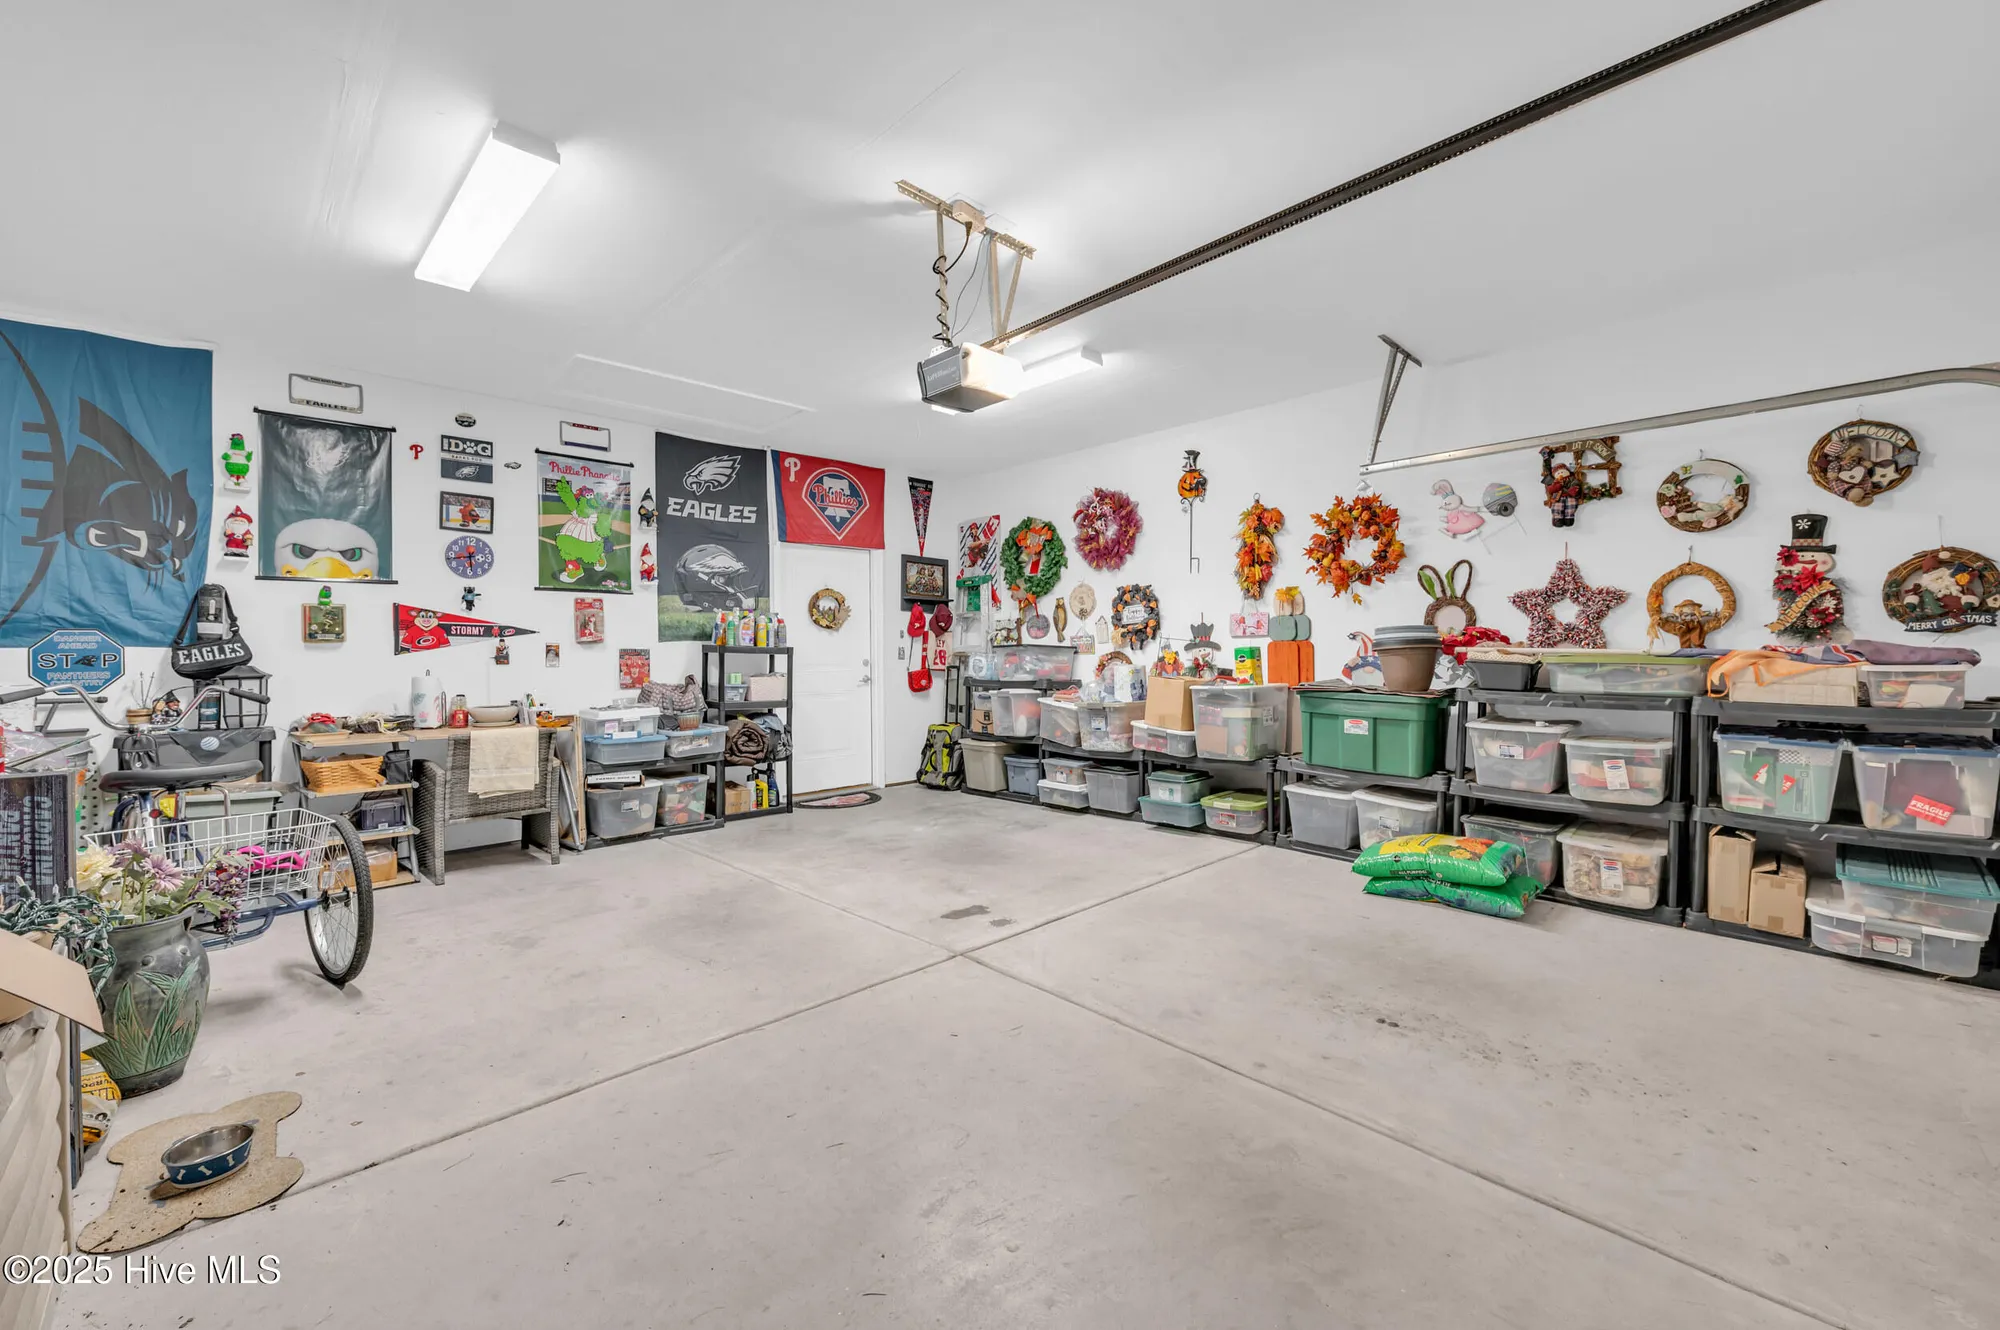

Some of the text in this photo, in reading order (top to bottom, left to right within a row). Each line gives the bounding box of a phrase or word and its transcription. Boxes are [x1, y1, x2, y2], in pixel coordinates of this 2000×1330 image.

[306, 399, 347, 410] EAGLES
[549, 460, 581, 476] Phillie
[784, 457, 801, 482] P
[812, 483, 858, 508] Phillies
[666, 496, 758, 524] EAGLES
[1776, 585, 1821, 626] WELCOME
[450, 625, 485, 635] STORMY
[1907, 621, 1937, 630] MERRY
[177, 643, 245, 665] EAGLES
[1910, 800, 1951, 818] FRAGILE
[23, 795, 53, 886] CAROLINA
